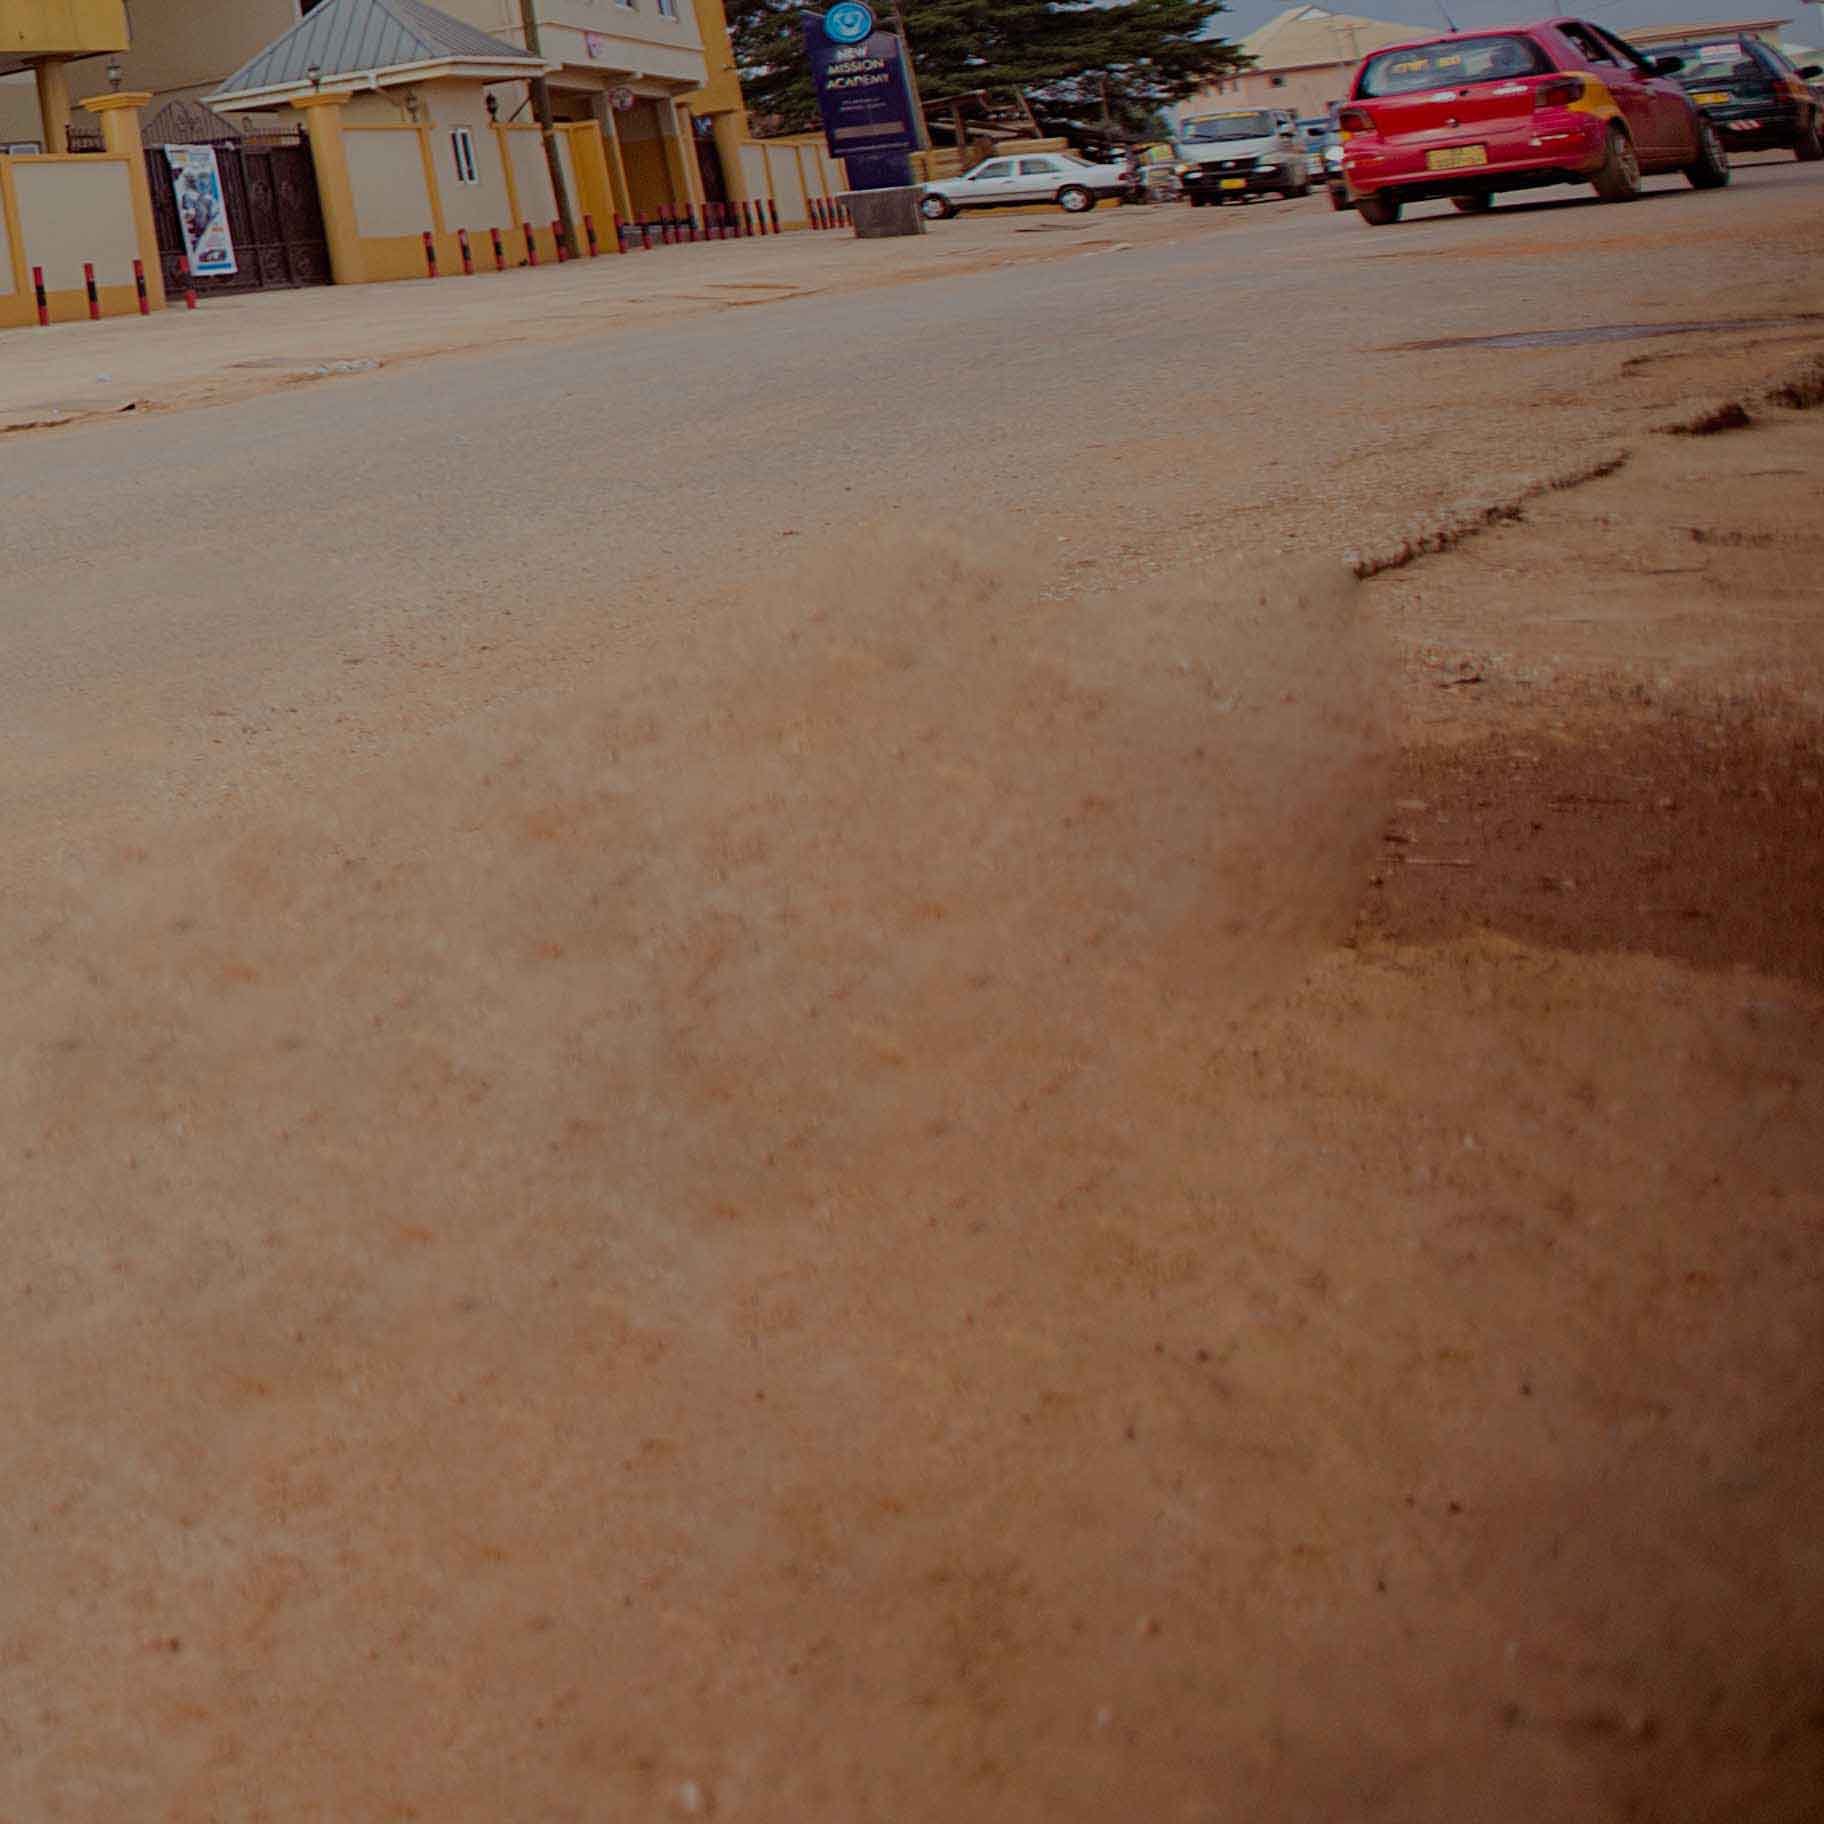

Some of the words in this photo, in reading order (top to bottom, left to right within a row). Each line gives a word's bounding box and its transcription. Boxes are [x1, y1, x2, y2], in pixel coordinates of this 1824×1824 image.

[836, 46, 867, 60] NEW
[828, 58, 885, 74] MISSION
[827, 73, 889, 89] ACADEMY
